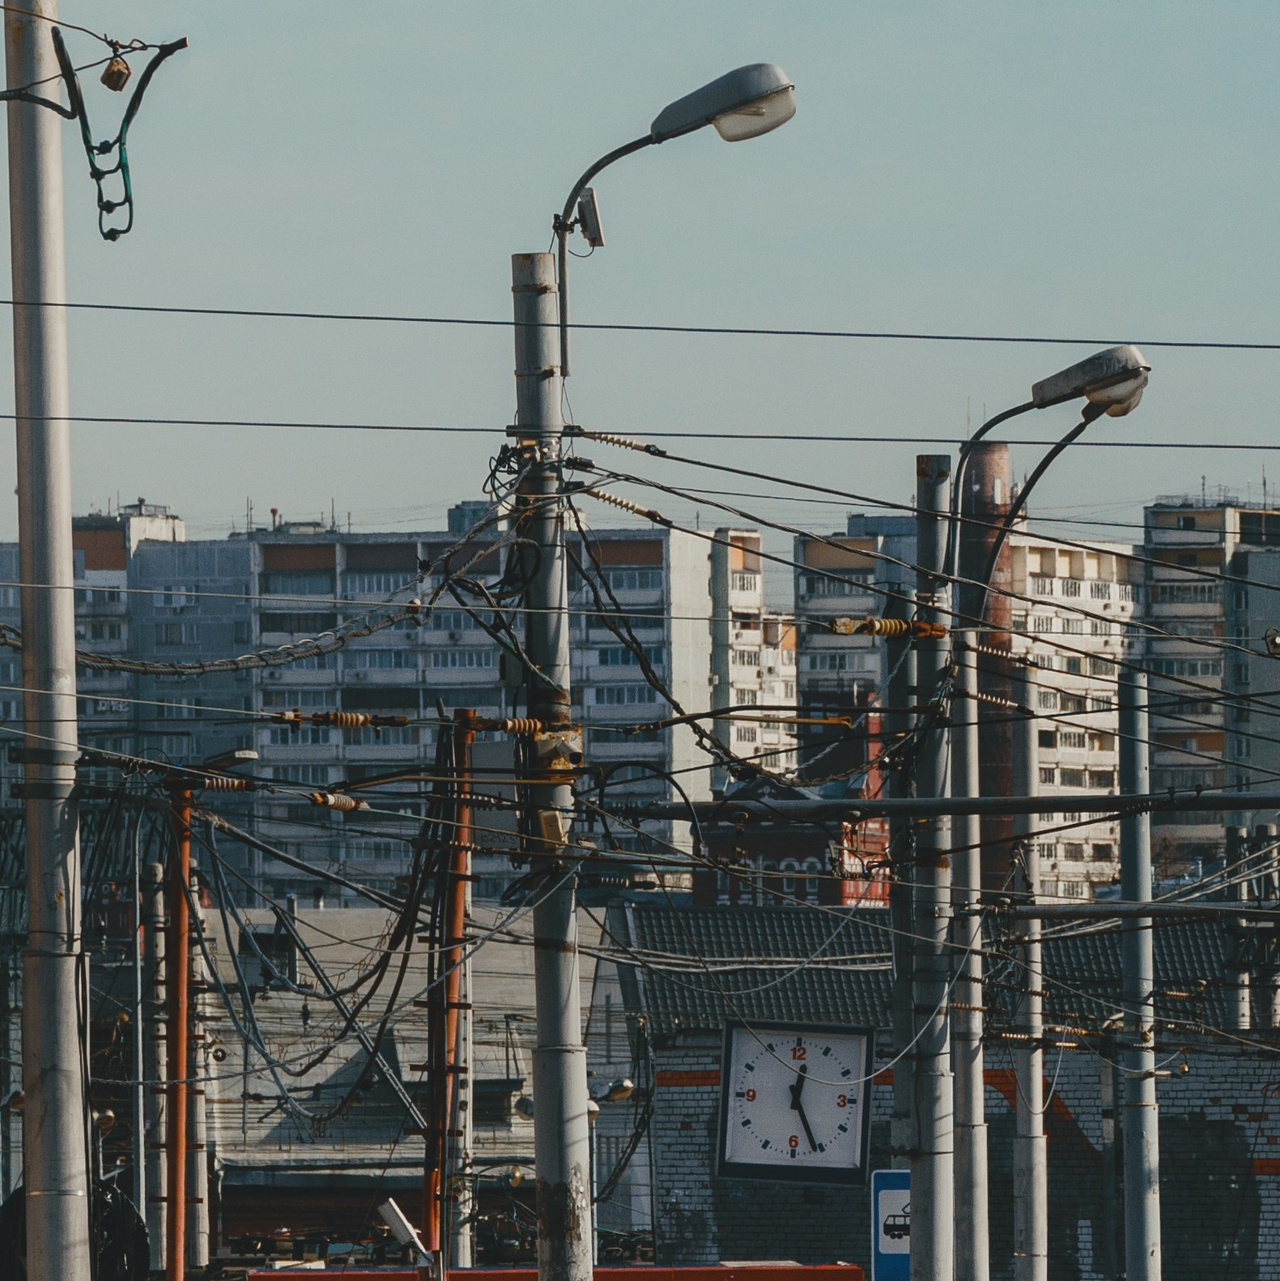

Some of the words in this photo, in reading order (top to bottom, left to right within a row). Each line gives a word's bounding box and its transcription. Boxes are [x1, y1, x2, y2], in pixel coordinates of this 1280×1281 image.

[790, 1047, 807, 1061] 12
[746, 1089, 757, 1102] 9
[836, 1094, 847, 1108] 3
[788, 1135, 799, 1148] 6
